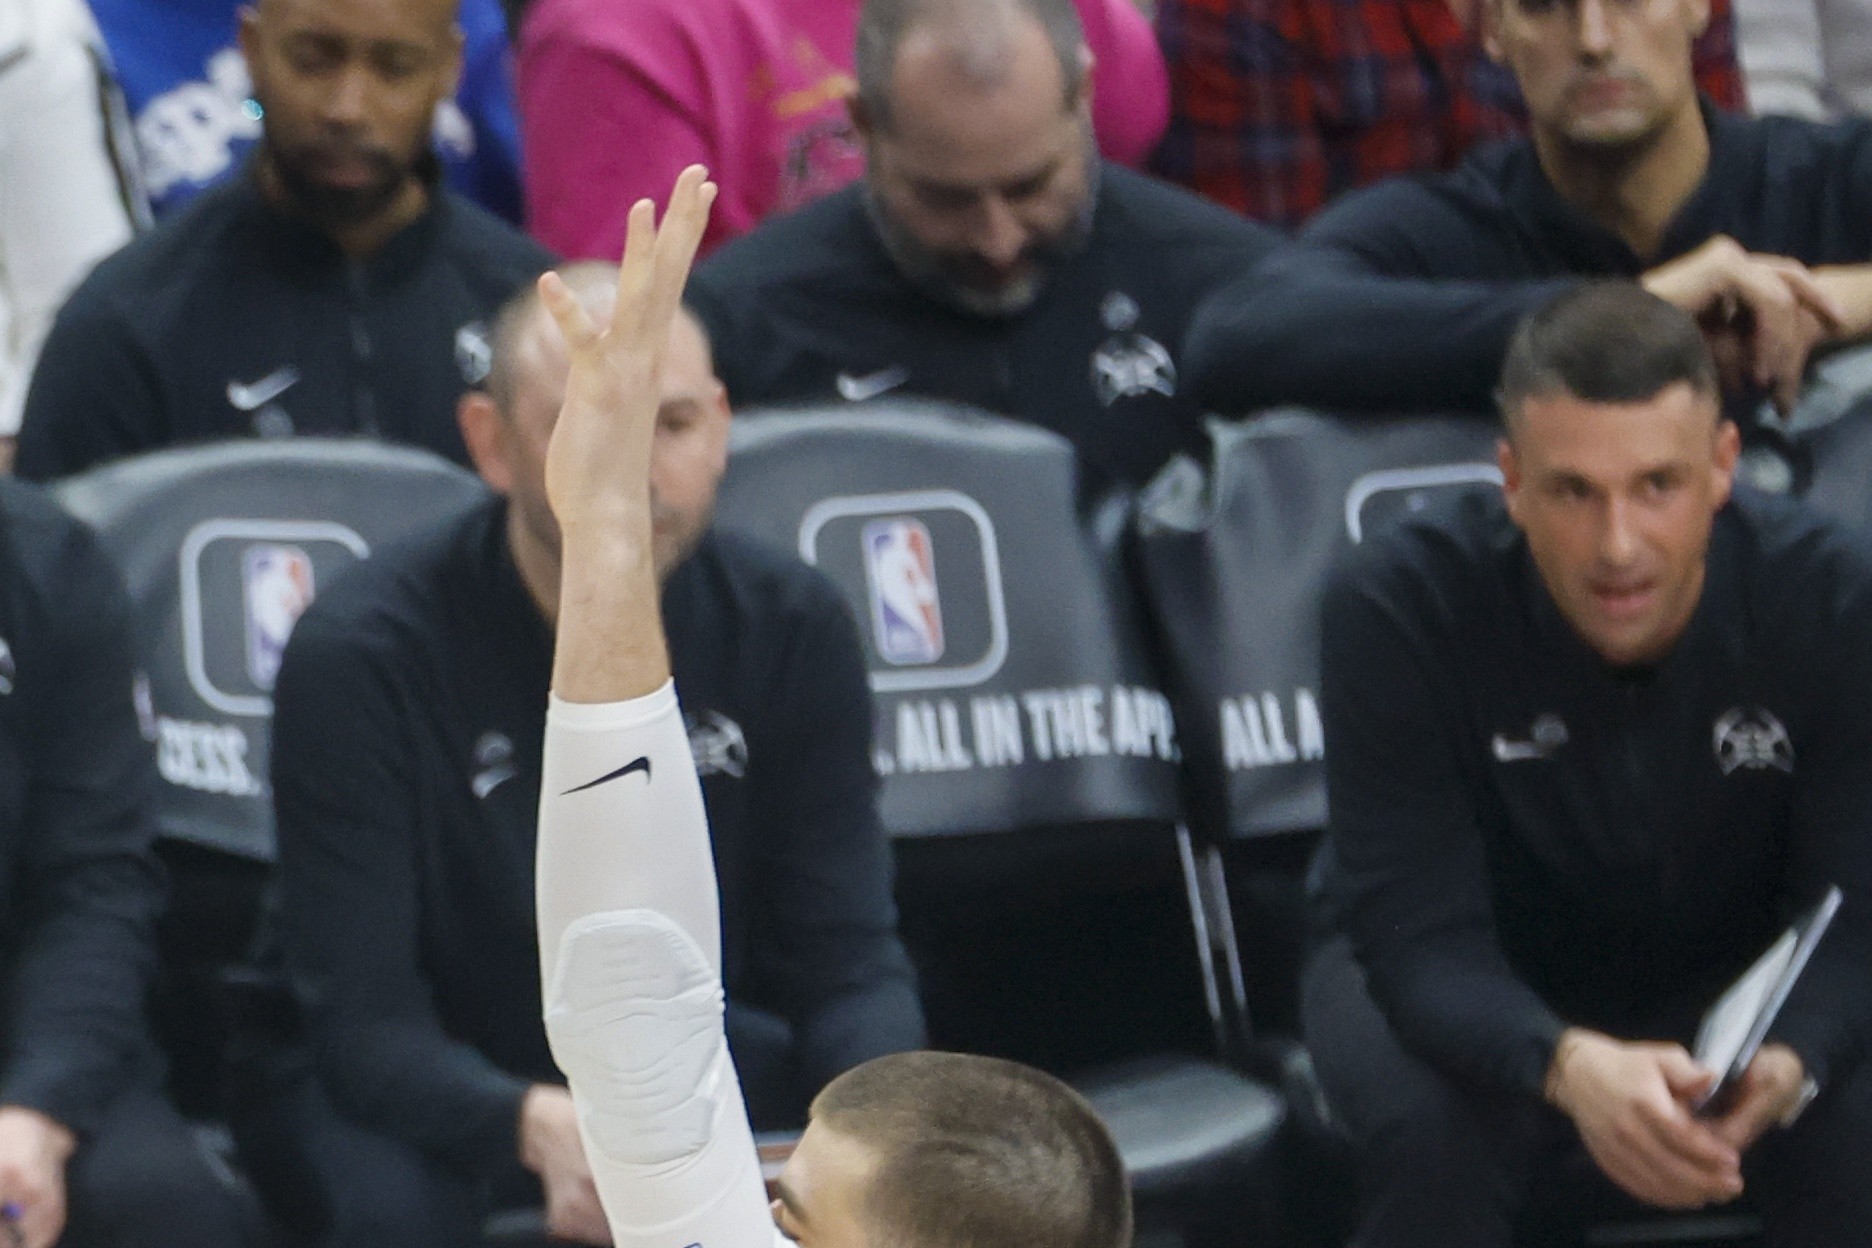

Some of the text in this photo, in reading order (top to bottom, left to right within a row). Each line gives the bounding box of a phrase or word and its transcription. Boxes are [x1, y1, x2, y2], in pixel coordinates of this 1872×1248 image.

[895, 699, 972, 773] ALL
[971, 696, 1024, 767] IN
[1023, 685, 1109, 761] THE
[1220, 692, 1296, 770] ALL
